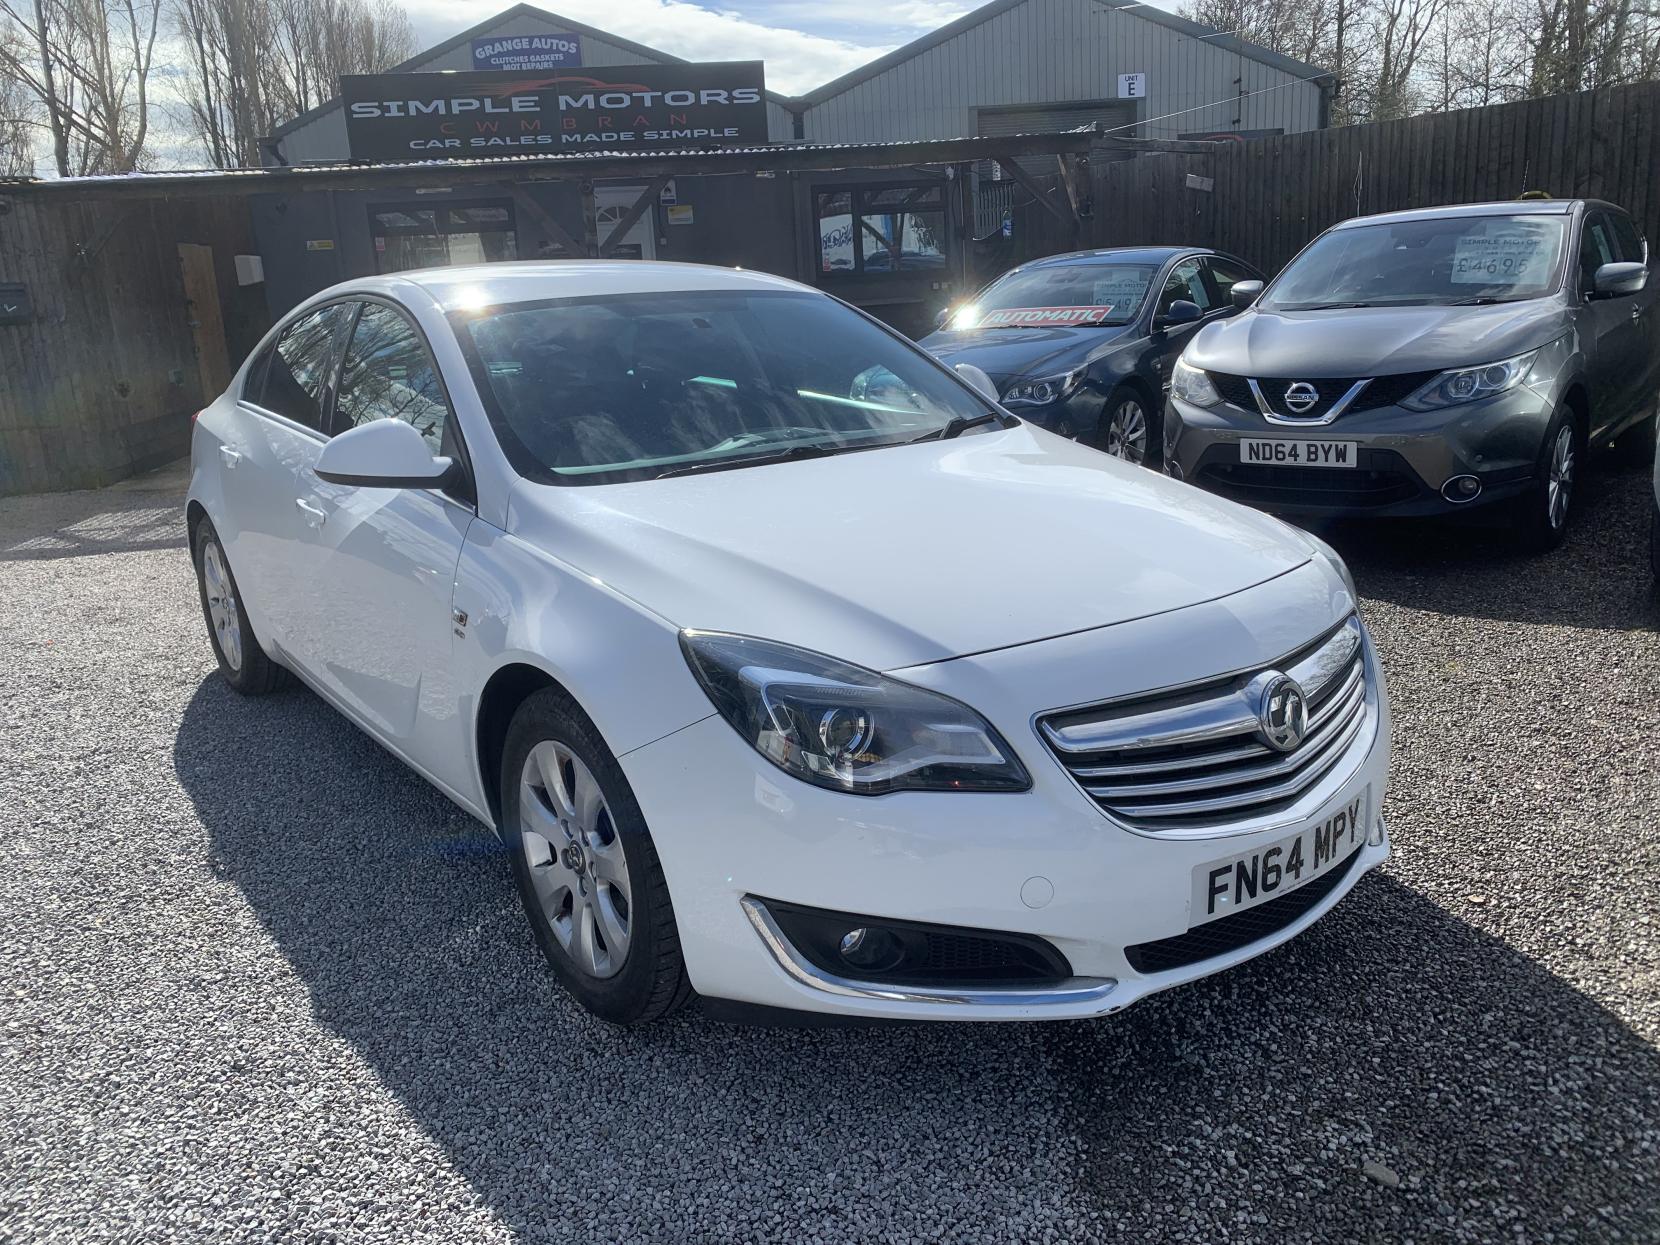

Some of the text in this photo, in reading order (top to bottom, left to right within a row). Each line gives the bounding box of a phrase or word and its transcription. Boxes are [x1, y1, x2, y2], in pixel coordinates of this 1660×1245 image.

[475, 38, 578, 59] GRANGE AUTOS
[490, 53, 564, 65] CLUTCHES GASKETS
[502, 61, 554, 71] MOT REPAIRS
[1127, 81, 1136, 96] E
[350, 88, 761, 118] SIMPLE MOTORS
[439, 113, 687, 134] CWMBRAN
[409, 127, 740, 149] CAR SALES MADE SIMPLE
[1456, 257, 1529, 275] £4695
[988, 309, 1105, 324] AUTOMATIC
[1248, 442, 1348, 463] ND64 BYW
[1207, 799, 1361, 916] FN64 MPY
